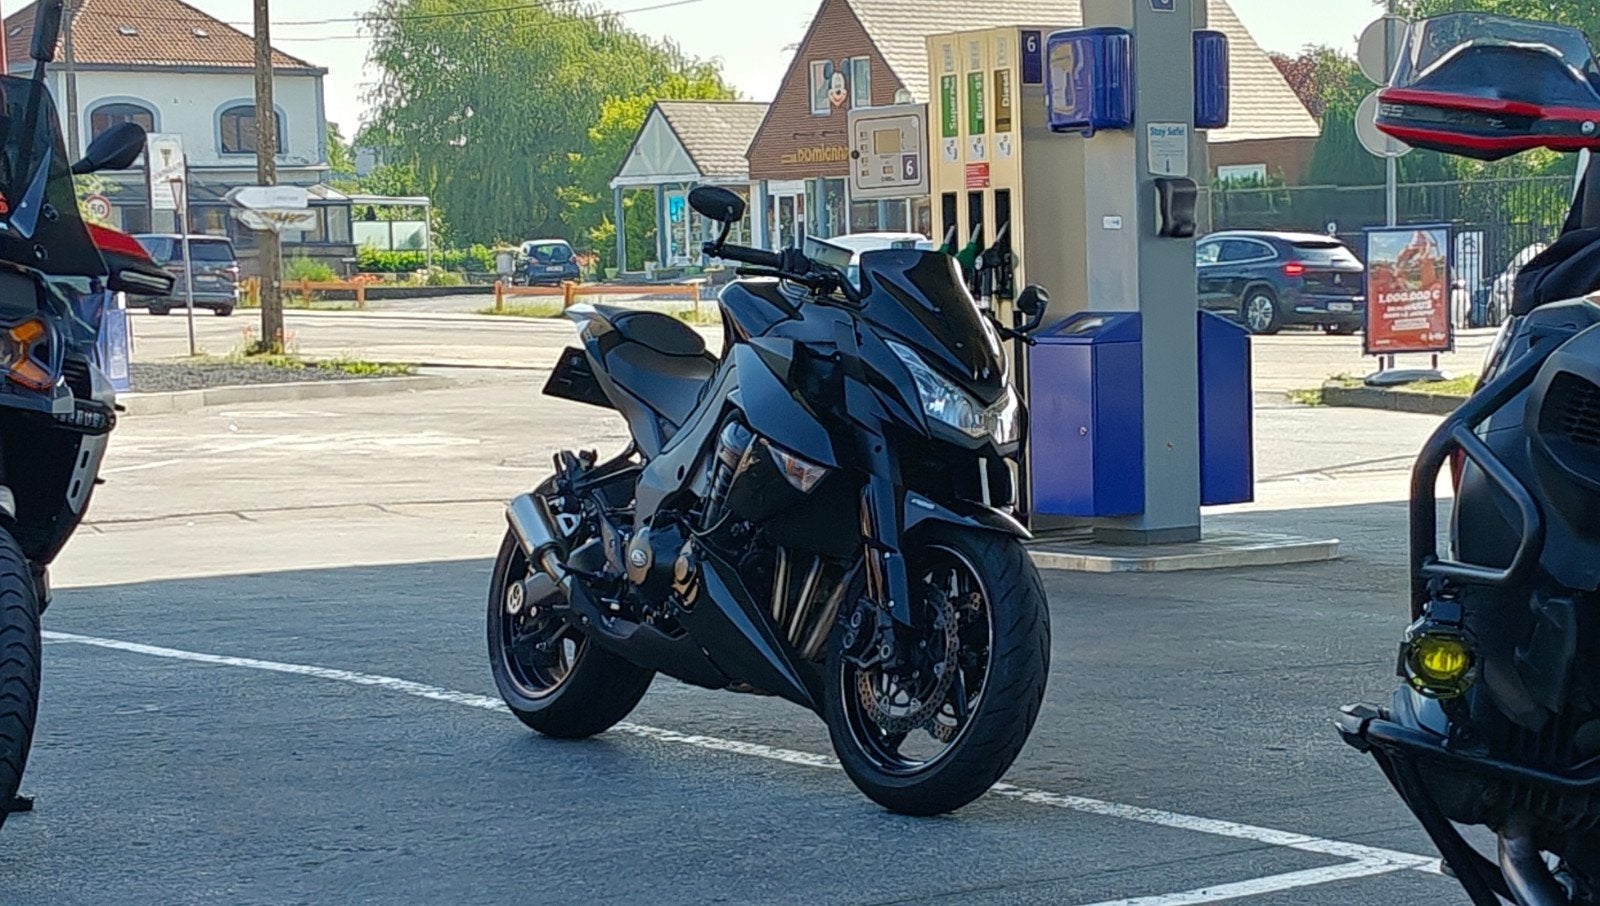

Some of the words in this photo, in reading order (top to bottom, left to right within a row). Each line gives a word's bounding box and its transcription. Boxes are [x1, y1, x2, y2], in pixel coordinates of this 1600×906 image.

[1027, 36, 1036, 53] 6
[974, 74, 983, 90] 95
[1001, 71, 1010, 107] Diesel
[974, 91, 984, 119] Euro
[1150, 127, 1166, 138] Stay
[906, 160, 914, 176] 6
[90, 203, 105, 215] 50
